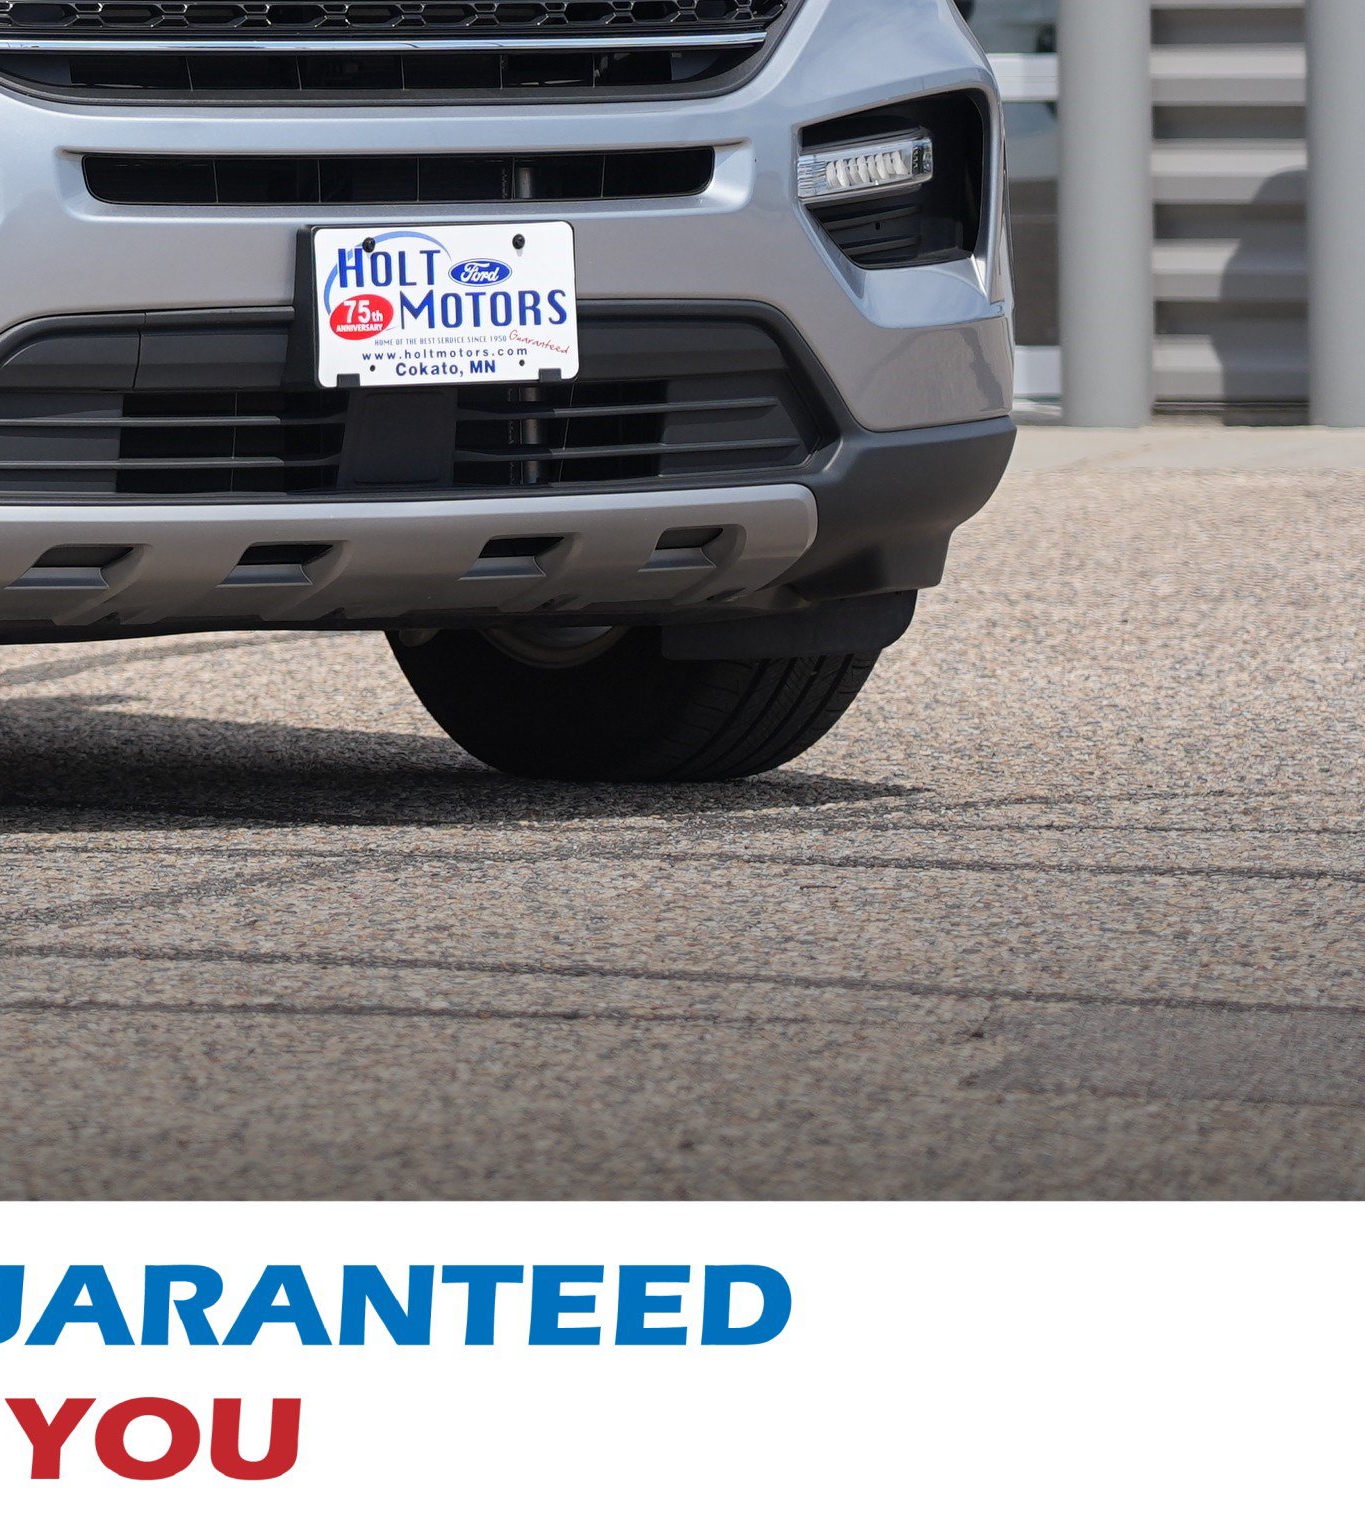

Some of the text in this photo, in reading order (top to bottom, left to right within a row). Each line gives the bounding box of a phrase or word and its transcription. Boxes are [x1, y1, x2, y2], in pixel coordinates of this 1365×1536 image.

[337, 248, 441, 288] HOLT
[460, 261, 500, 284] Ford
[343, 300, 383, 324] 75th
[399, 289, 567, 330] MOTORS
[336, 323, 383, 332] ANNIVERSARY
[508, 329, 571, 355] Guaranteed
[362, 347, 528, 361] www.holtmotors.com
[395, 360, 497, 377] Cokato, MN
